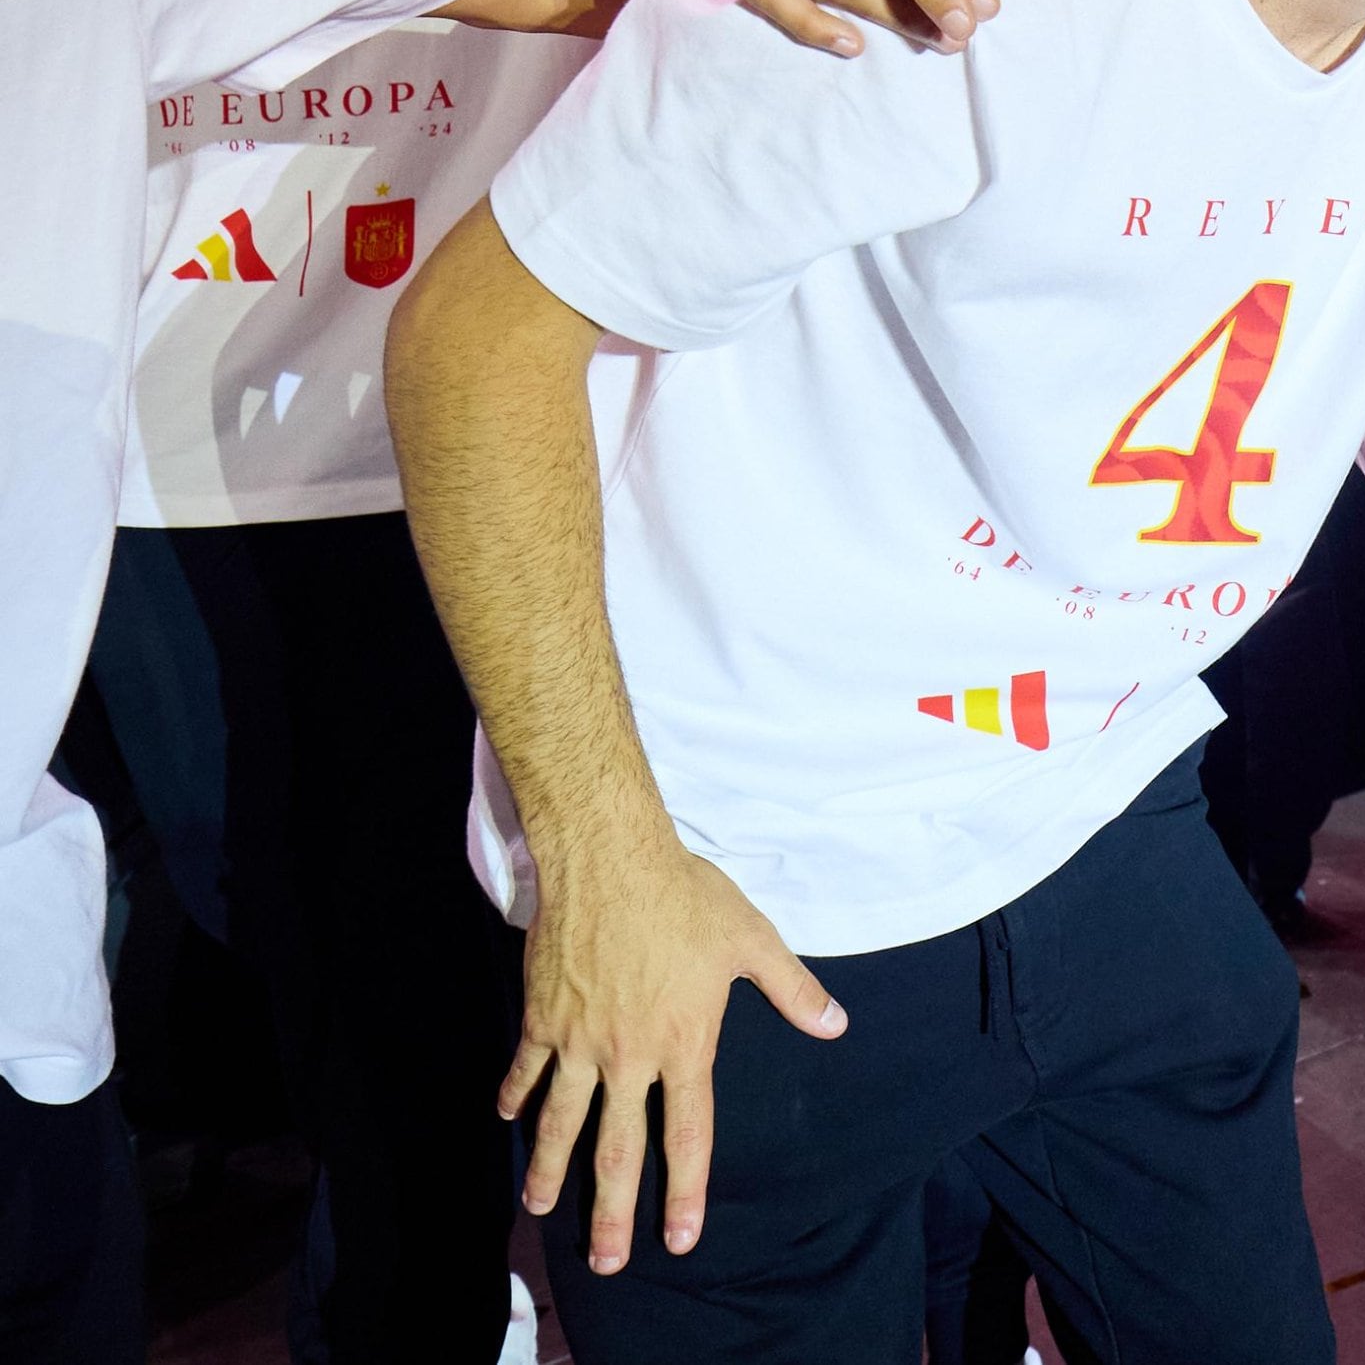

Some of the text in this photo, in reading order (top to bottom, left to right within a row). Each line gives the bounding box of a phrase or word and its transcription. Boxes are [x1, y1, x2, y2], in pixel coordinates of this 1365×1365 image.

[160, 79, 455, 127] DE EUROPA
[1088, 279, 1294, 545] 4
